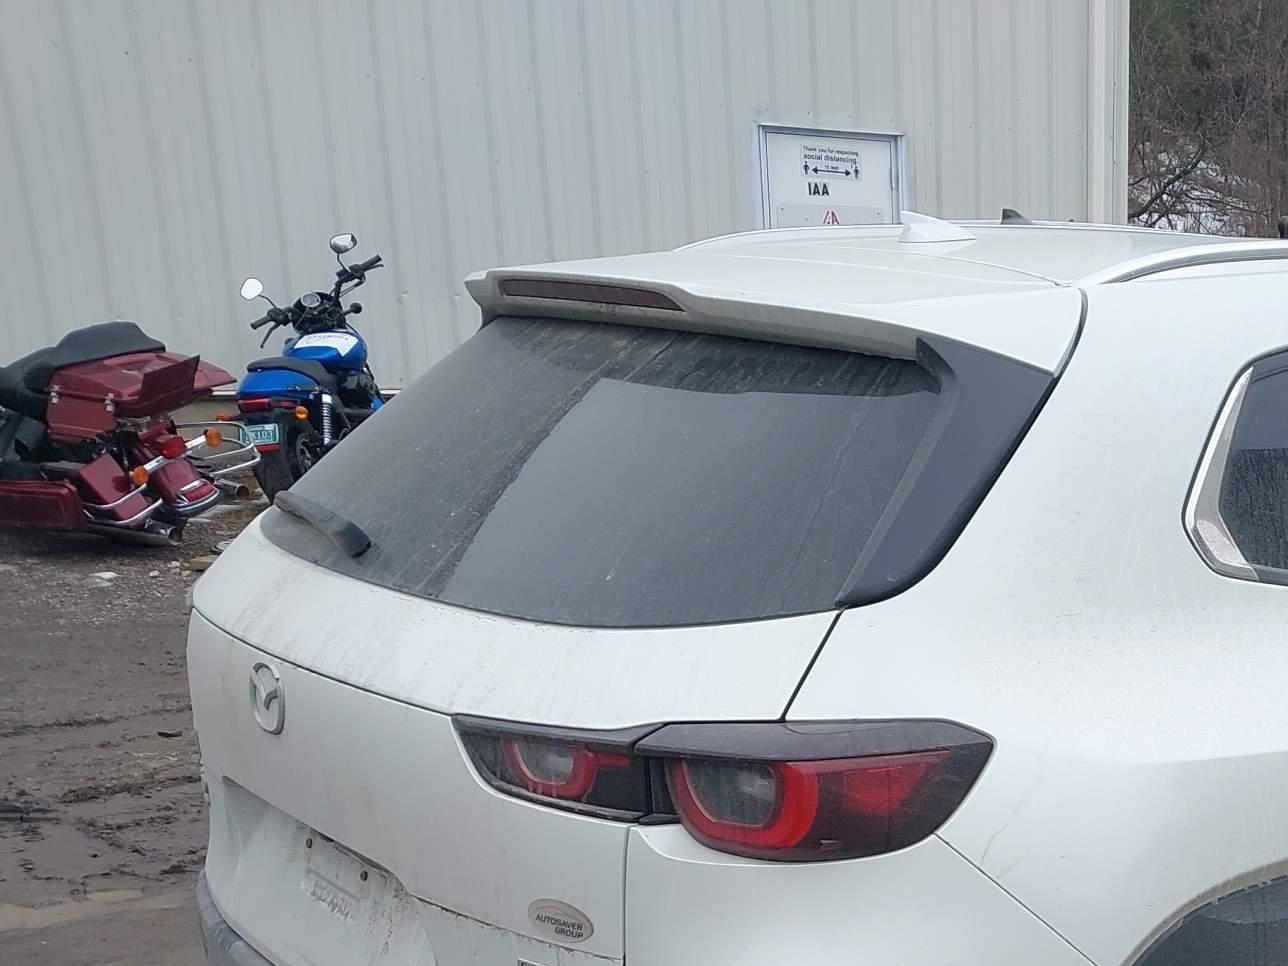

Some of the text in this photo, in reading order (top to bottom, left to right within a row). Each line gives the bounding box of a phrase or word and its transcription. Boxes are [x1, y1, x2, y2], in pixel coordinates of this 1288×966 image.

[803, 145, 817, 153] Thank
[803, 153, 823, 161] social
[808, 182, 830, 196] IAA
[535, 913, 583, 931] AUTOSAVER
[554, 927, 584, 939] GROUP
